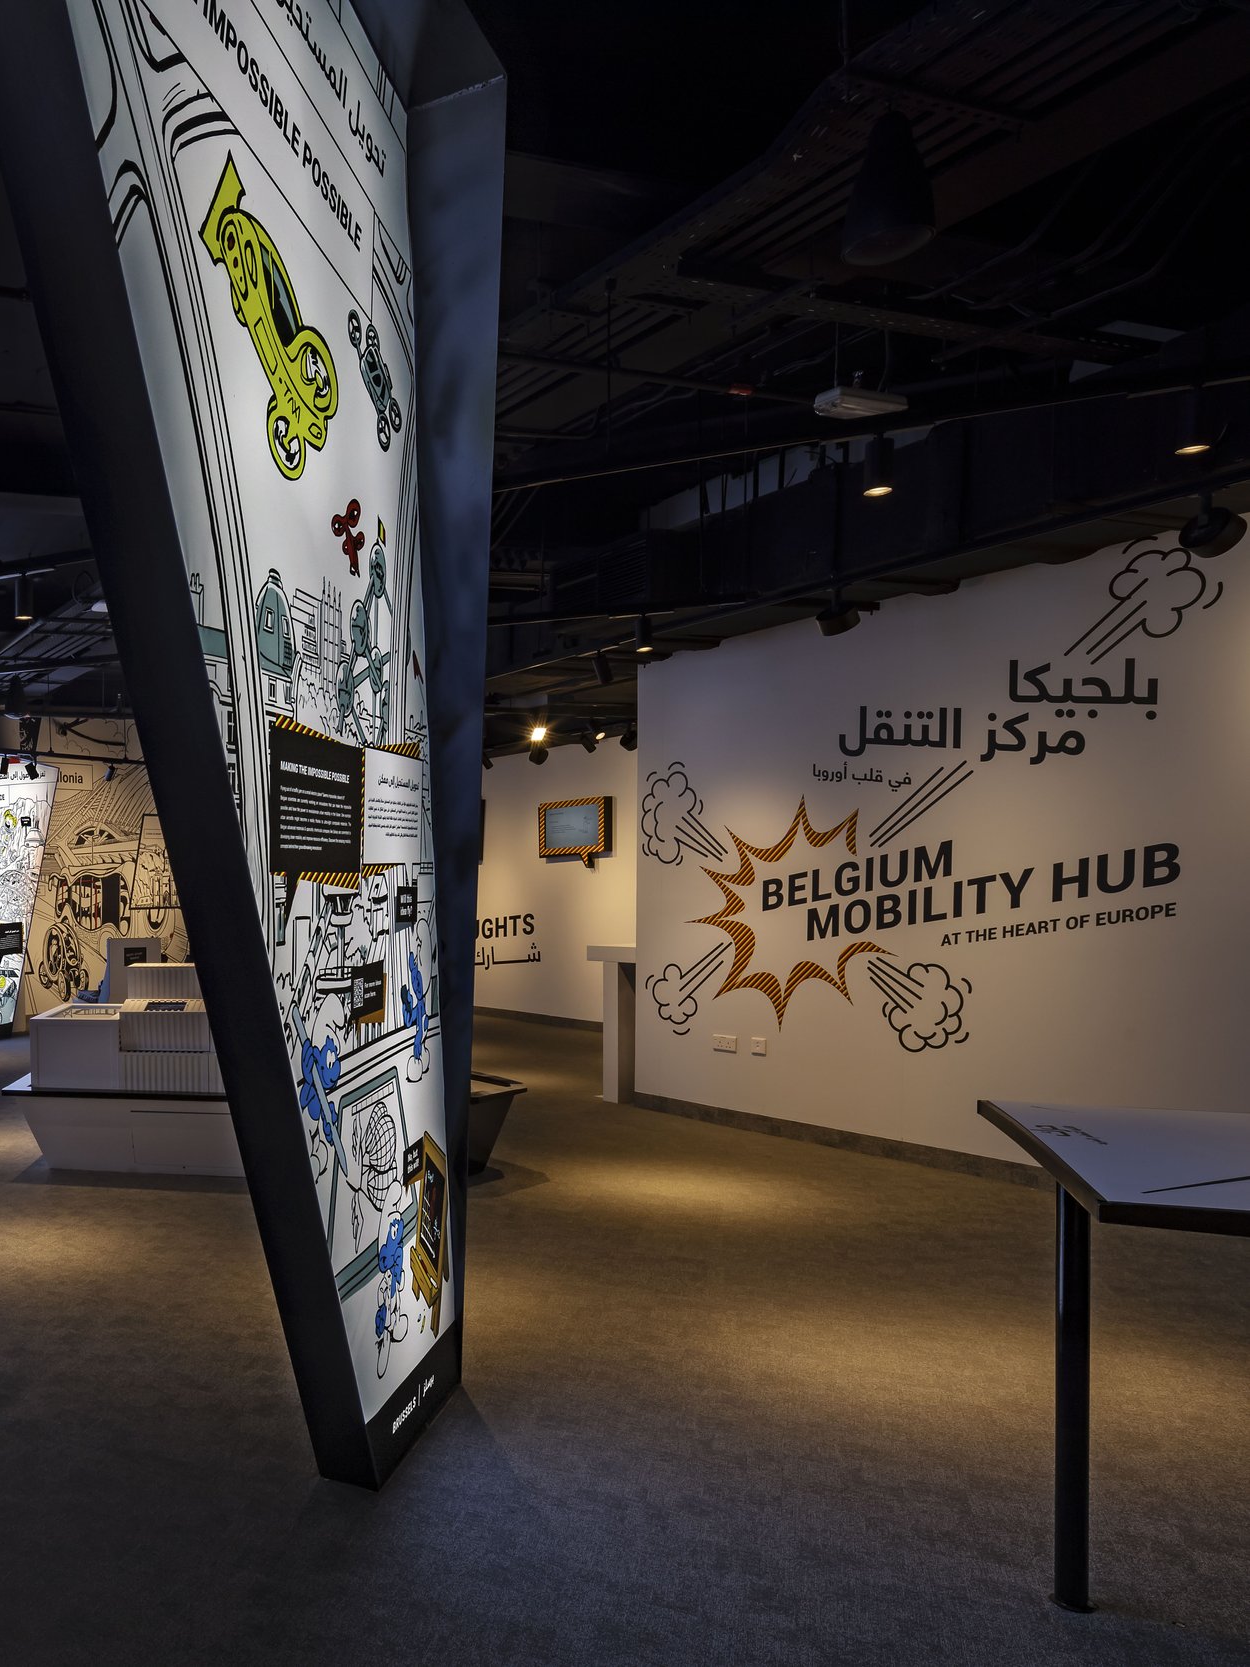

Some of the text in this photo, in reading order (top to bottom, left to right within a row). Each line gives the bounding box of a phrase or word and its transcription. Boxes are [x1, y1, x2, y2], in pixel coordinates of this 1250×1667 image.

[203, 0, 363, 252] IMPOSSIBLE POSSIBLE
[348, 100, 386, 178] تحويل
[1008, 658, 1159, 721] بلجيكا
[838, 705, 1086, 766] مركز التنقل
[57, 771, 84, 784] lonia
[280, 760, 350, 784] MAKING THE IMPOSSIBLE POSSIBLE
[812, 762, 912, 793] في قلب أوروبا
[762, 839, 954, 912] BELGIUM
[806, 842, 1181, 942] MOBILITY HUB
[940, 902, 1177, 947] AT THE HEART OF EUROPE
[392, 1396, 416, 1434] BRUSSELS
